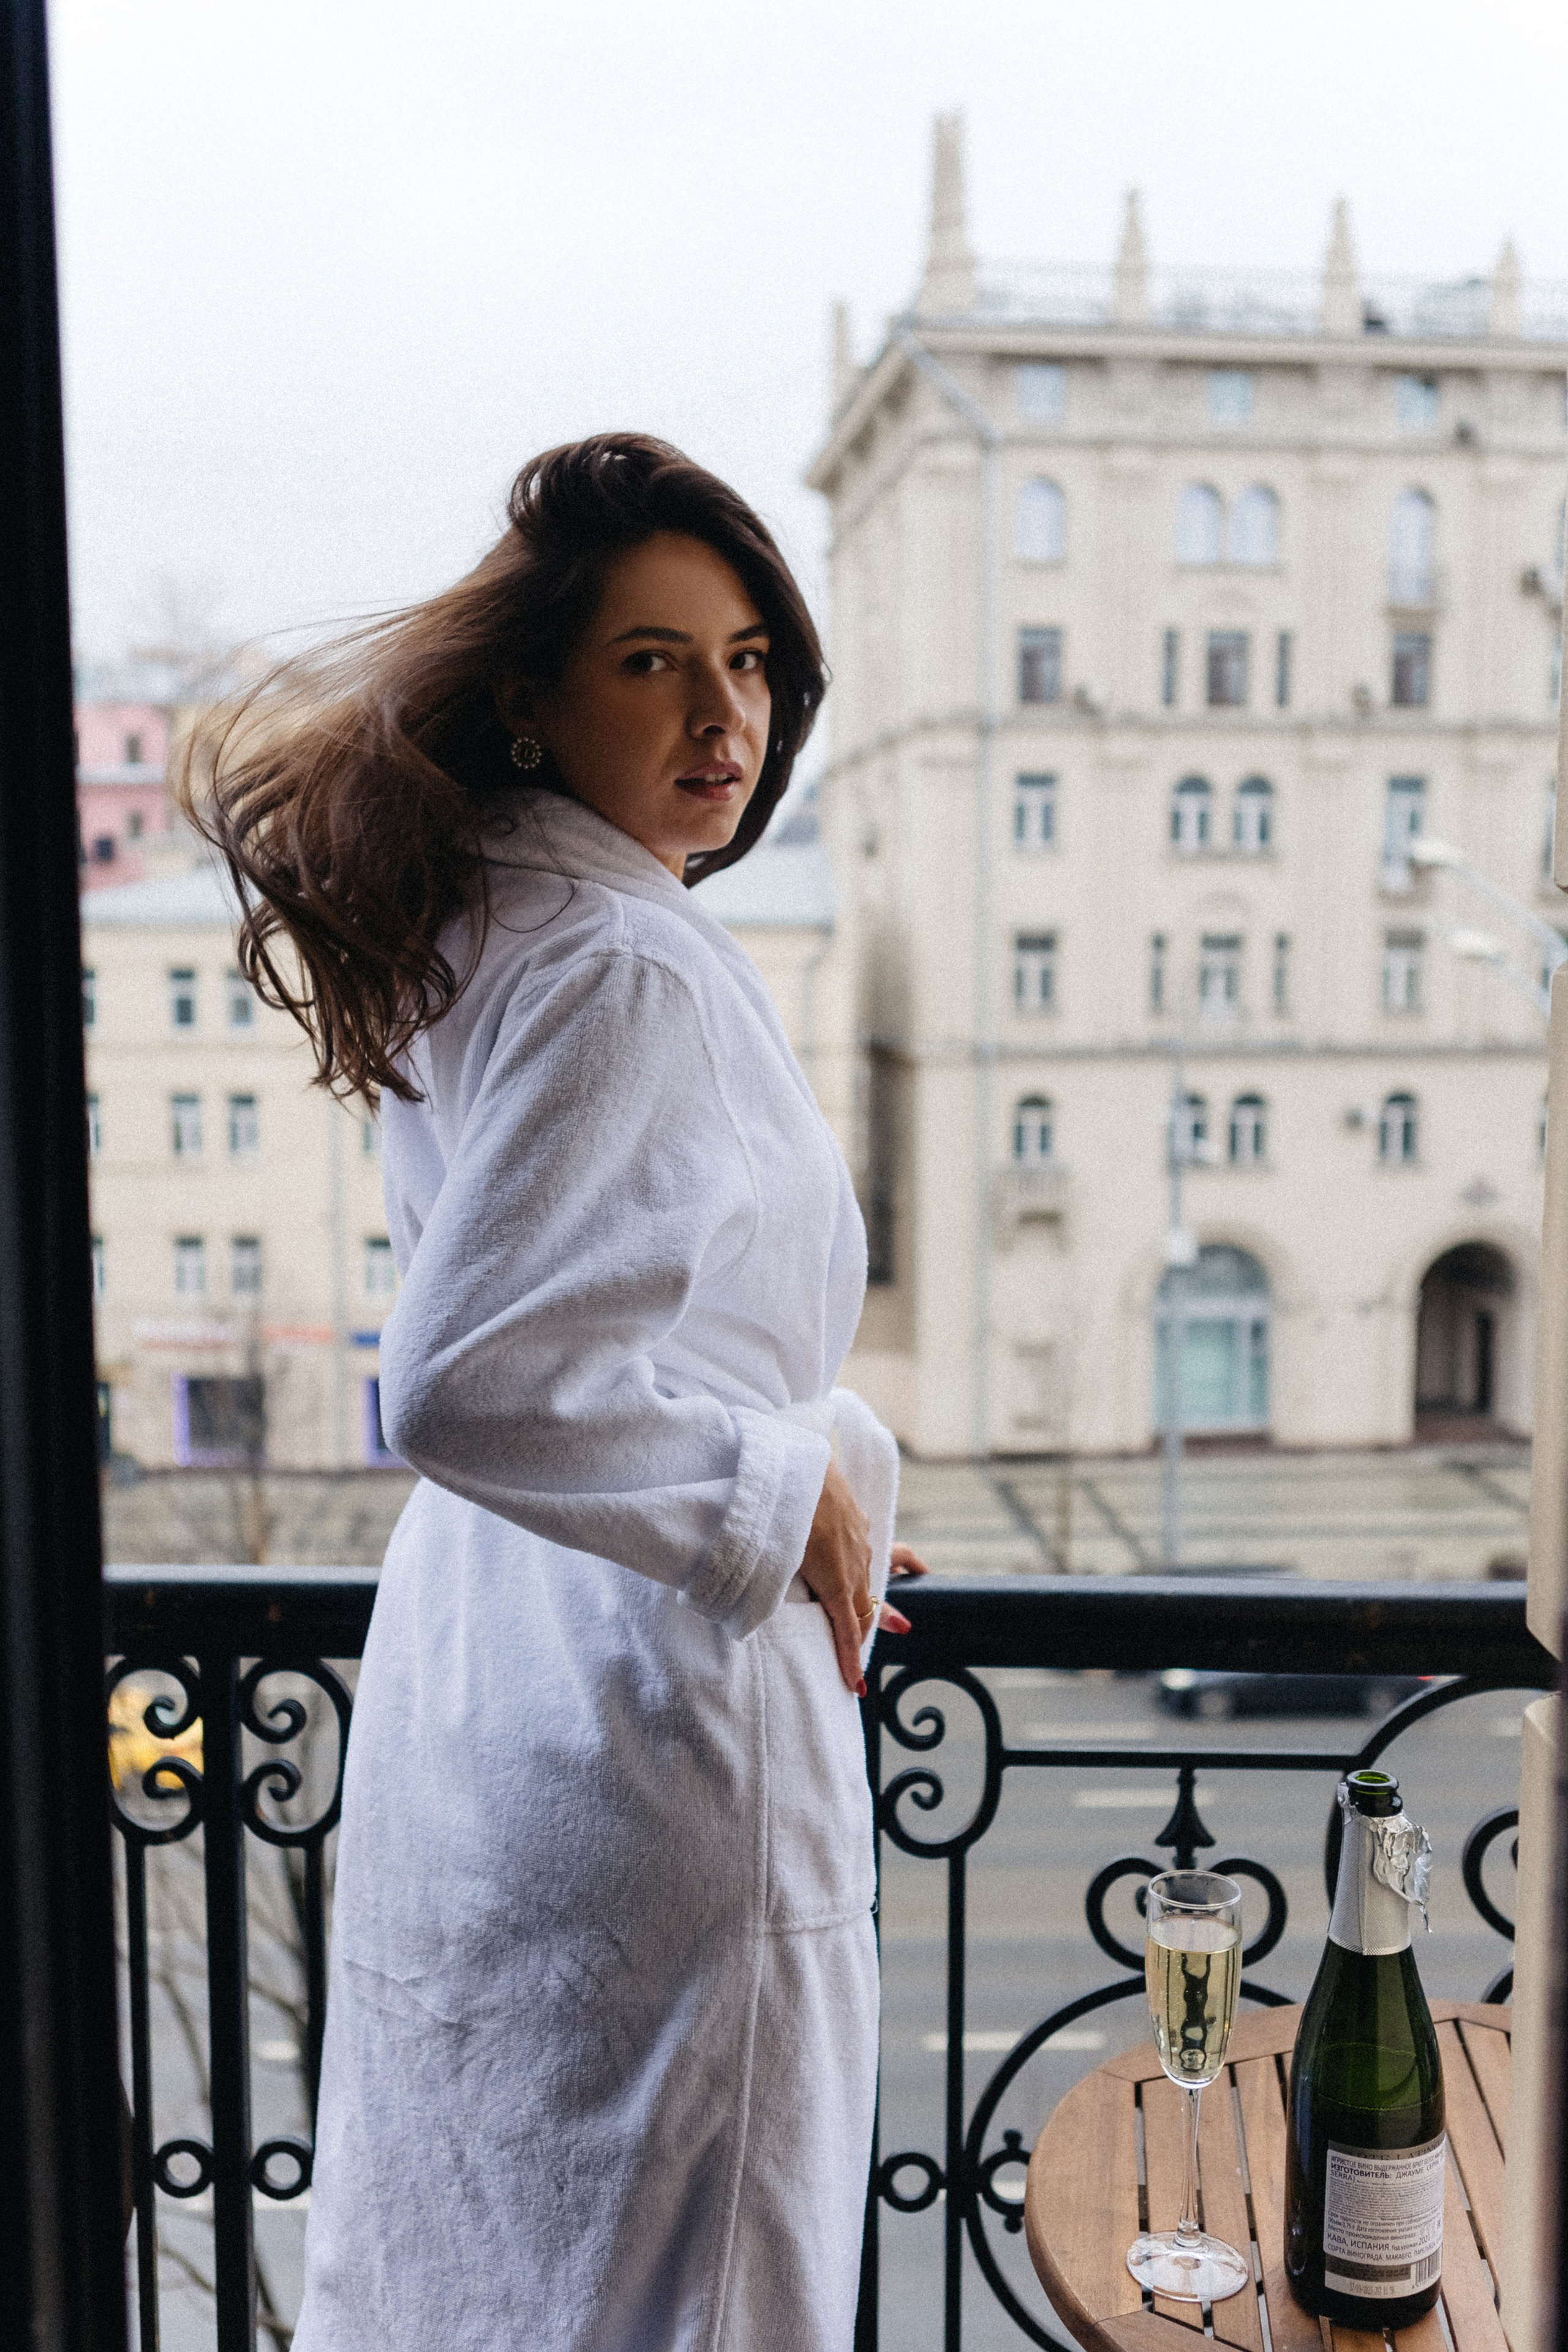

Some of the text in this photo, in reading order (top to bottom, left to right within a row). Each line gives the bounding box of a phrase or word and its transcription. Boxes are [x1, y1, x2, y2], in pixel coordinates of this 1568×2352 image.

[1330, 2169, 1355, 2182] SERRA)
[1331, 2163, 1392, 2179] ИЗГОТОВИТЕЛЬ:
[1396, 2167, 1425, 2179] ДЖАУМЕ
[1328, 2223, 1344, 2234] Место
[1345, 2230, 1390, 2241] происхождения
[1327, 2233, 1349, 2247] КАВА,
[1419, 2233, 1430, 2245] 2021
[1327, 2244, 1346, 2255] СОРТА
